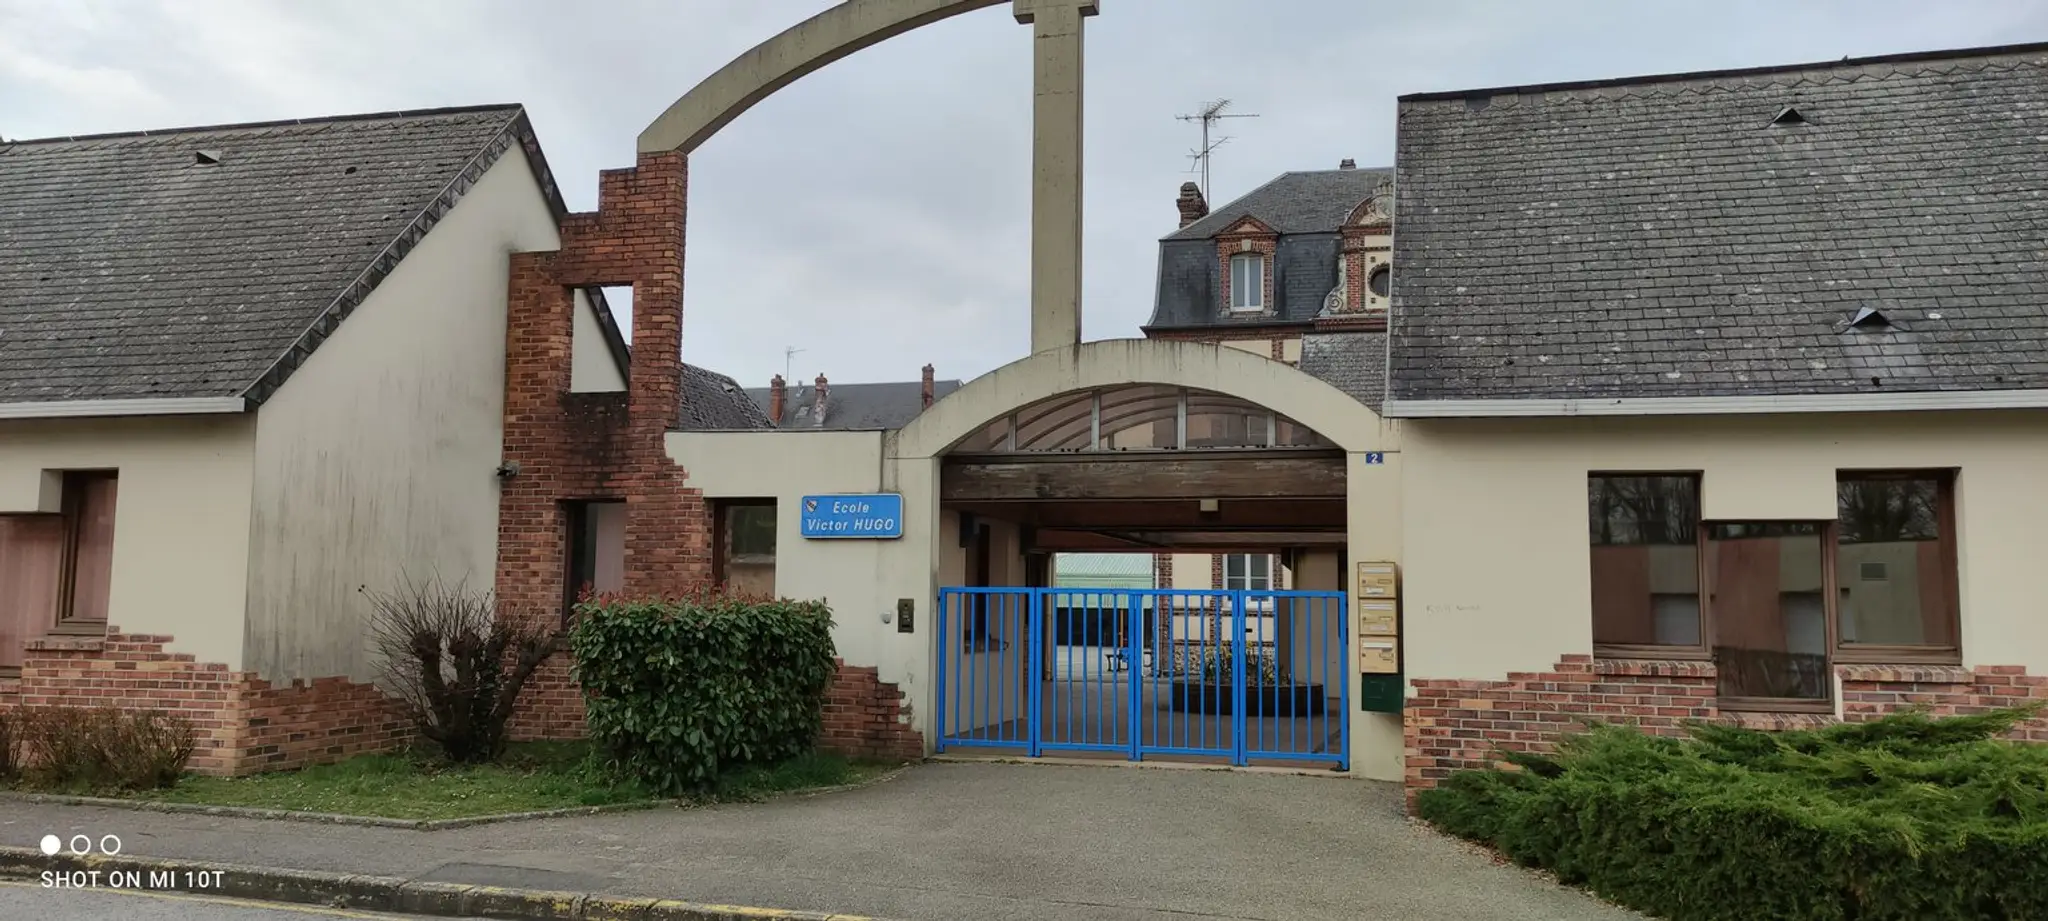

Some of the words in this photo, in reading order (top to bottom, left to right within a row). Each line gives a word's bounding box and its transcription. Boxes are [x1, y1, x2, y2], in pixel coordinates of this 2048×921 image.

[1371, 453, 1378, 464] 2
[833, 501, 869, 513] Ecole
[807, 519, 848, 531] Victor
[854, 518, 894, 530] HUGO
